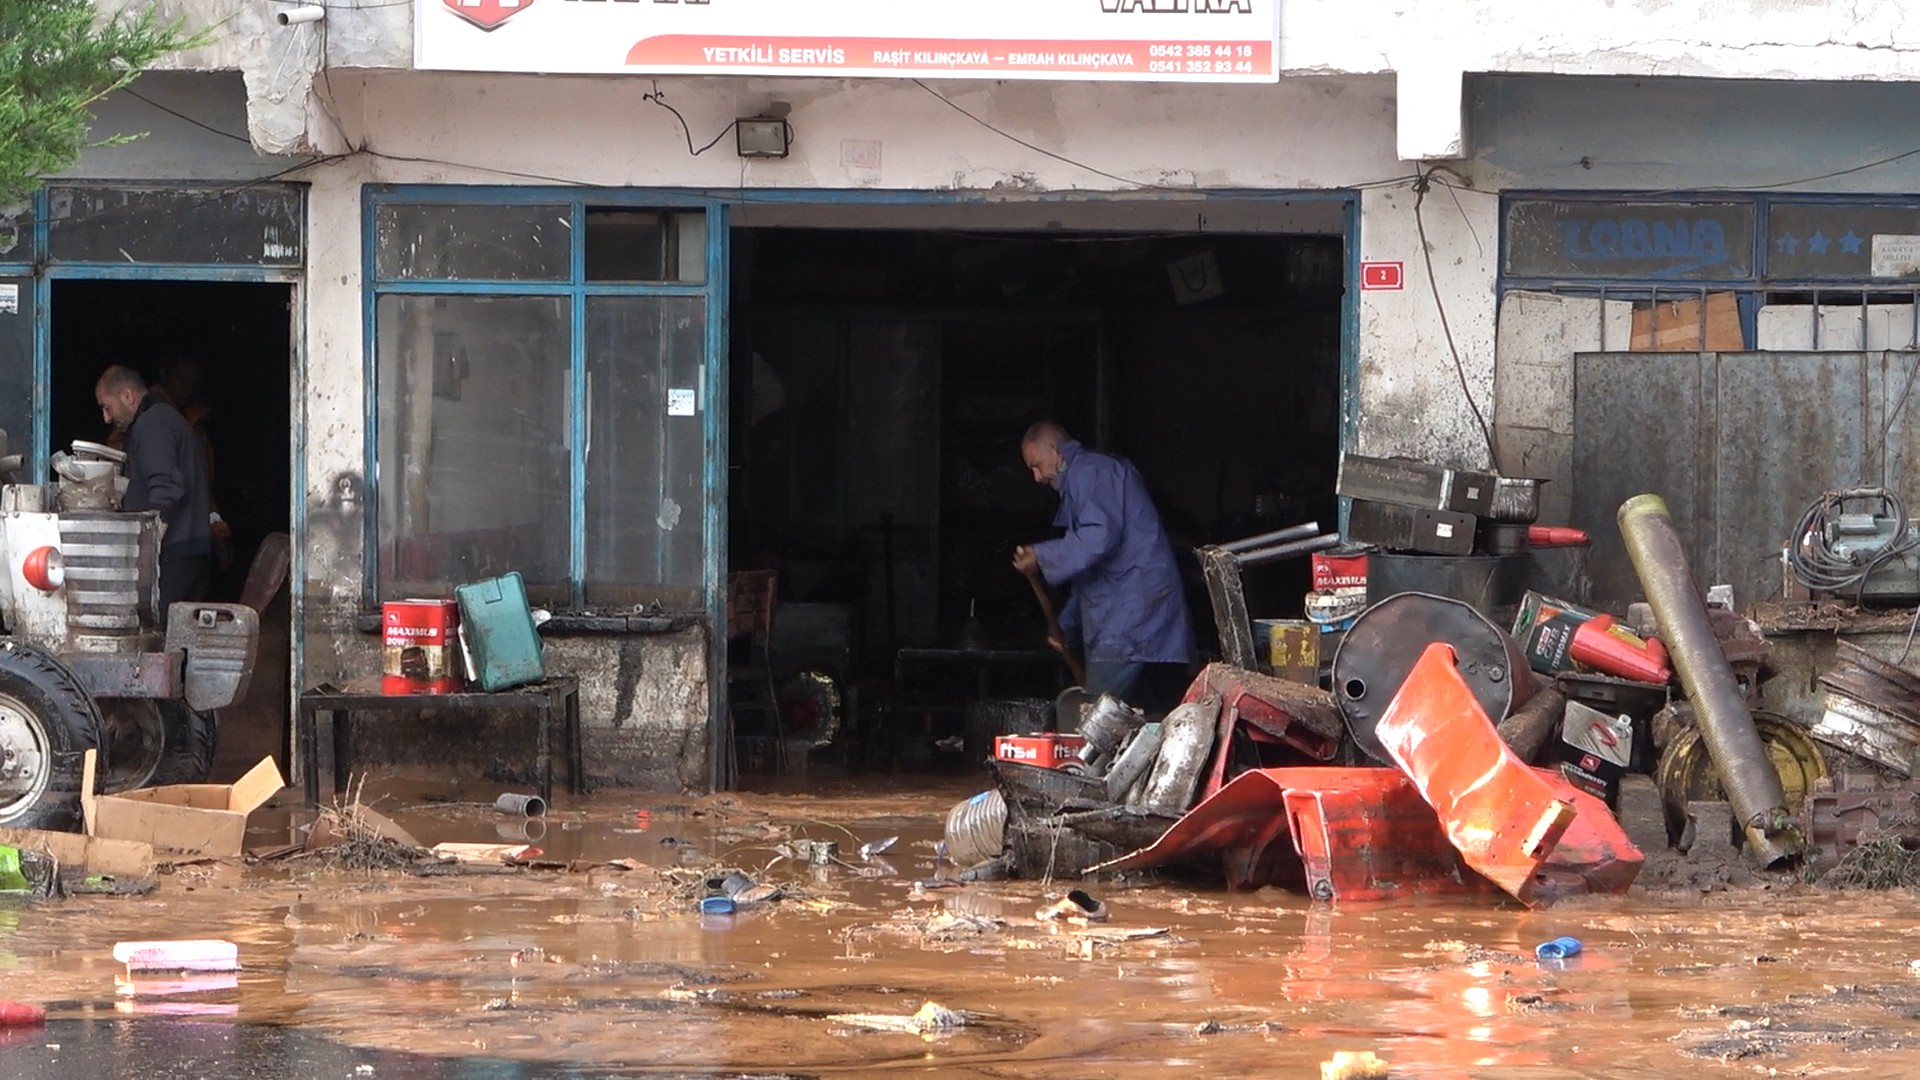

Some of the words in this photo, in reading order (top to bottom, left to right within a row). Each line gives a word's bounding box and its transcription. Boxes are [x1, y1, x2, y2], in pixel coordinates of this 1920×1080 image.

[703, 43, 773, 63] YETKİLİ
[778, 44, 846, 64] SERVİS
[1149, 44, 1183, 57] 0542
[1186, 44, 1211, 57] 385
[1214, 44, 1232, 57] 44
[1236, 44, 1252, 57] 18
[873, 48, 912, 66] RAŞİT
[914, 51, 990, 68] KILINÇKAYA
[1008, 52, 1055, 65] EMRAH
[1057, 52, 1134, 69] KILINÇKAYA
[1149, 60, 1182, 73] 0541
[1186, 60, 1211, 73] 352
[1214, 60, 1232, 73] 93
[1234, 60, 1252, 73] 44
[1380, 269, 1387, 281] 2
[386, 626, 438, 637] MAXIMUS
